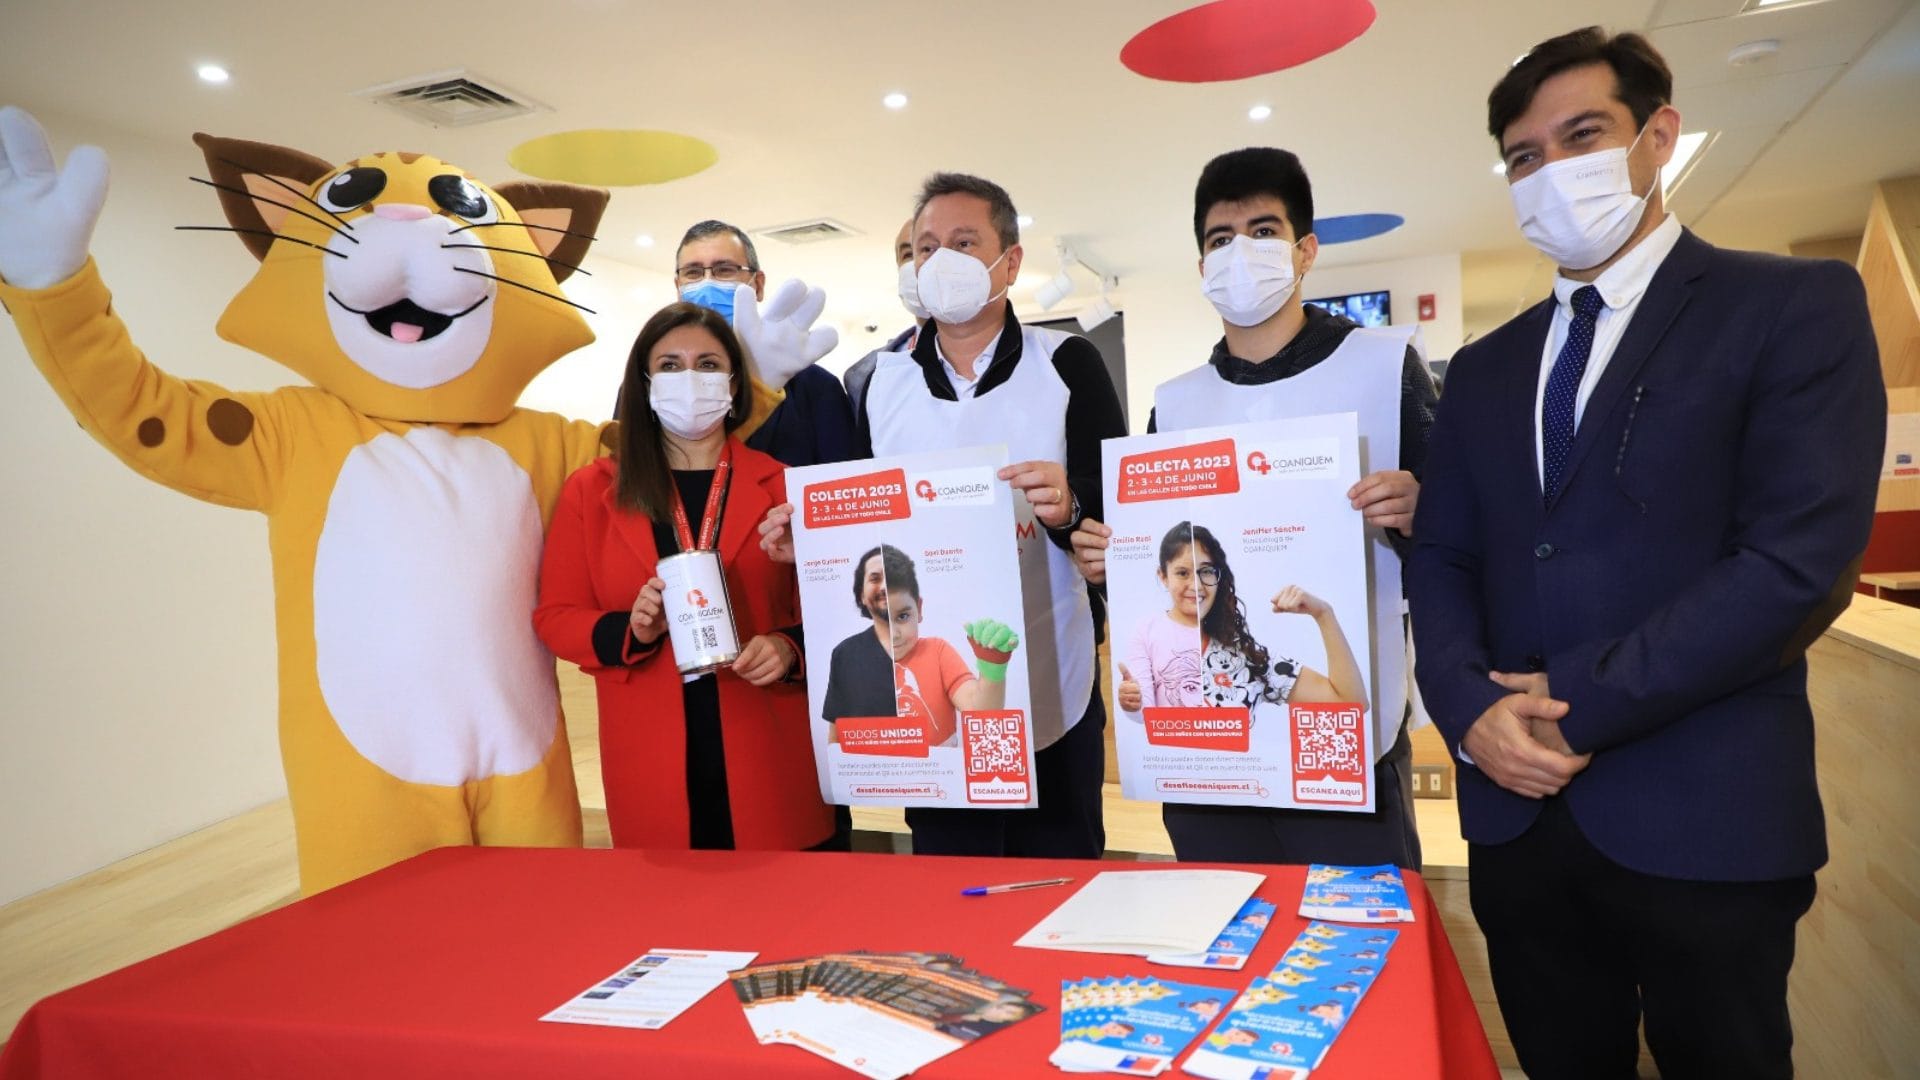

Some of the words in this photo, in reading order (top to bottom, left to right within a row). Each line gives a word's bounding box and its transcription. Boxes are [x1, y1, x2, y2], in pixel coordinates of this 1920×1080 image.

[1126, 459, 1191, 475] COLECTA
[1193, 455, 1231, 469] 2023
[1272, 456, 1334, 469] COANIQUEM
[1127, 479, 1134, 487] 2
[1141, 478, 1147, 486] 3
[1155, 476, 1161, 485] 4
[1164, 475, 1180, 484] DE
[1182, 472, 1217, 483] JUNIO
[809, 487, 867, 503] COLECTA
[869, 483, 902, 497] 2023
[938, 484, 990, 496] COANIQUEM
[812, 506, 818, 514] 2
[824, 505, 830, 513] 3
[837, 503, 843, 511] 4
[845, 501, 858, 511] DE
[860, 499, 890, 509] JUNIO
[1150, 719, 1191, 730] TODOS
[1193, 719, 1243, 730] UNIDOS
[842, 729, 878, 739] TODOS
[880, 728, 923, 738] UNIDOS
[1300, 787, 1338, 795] ESCANEA
